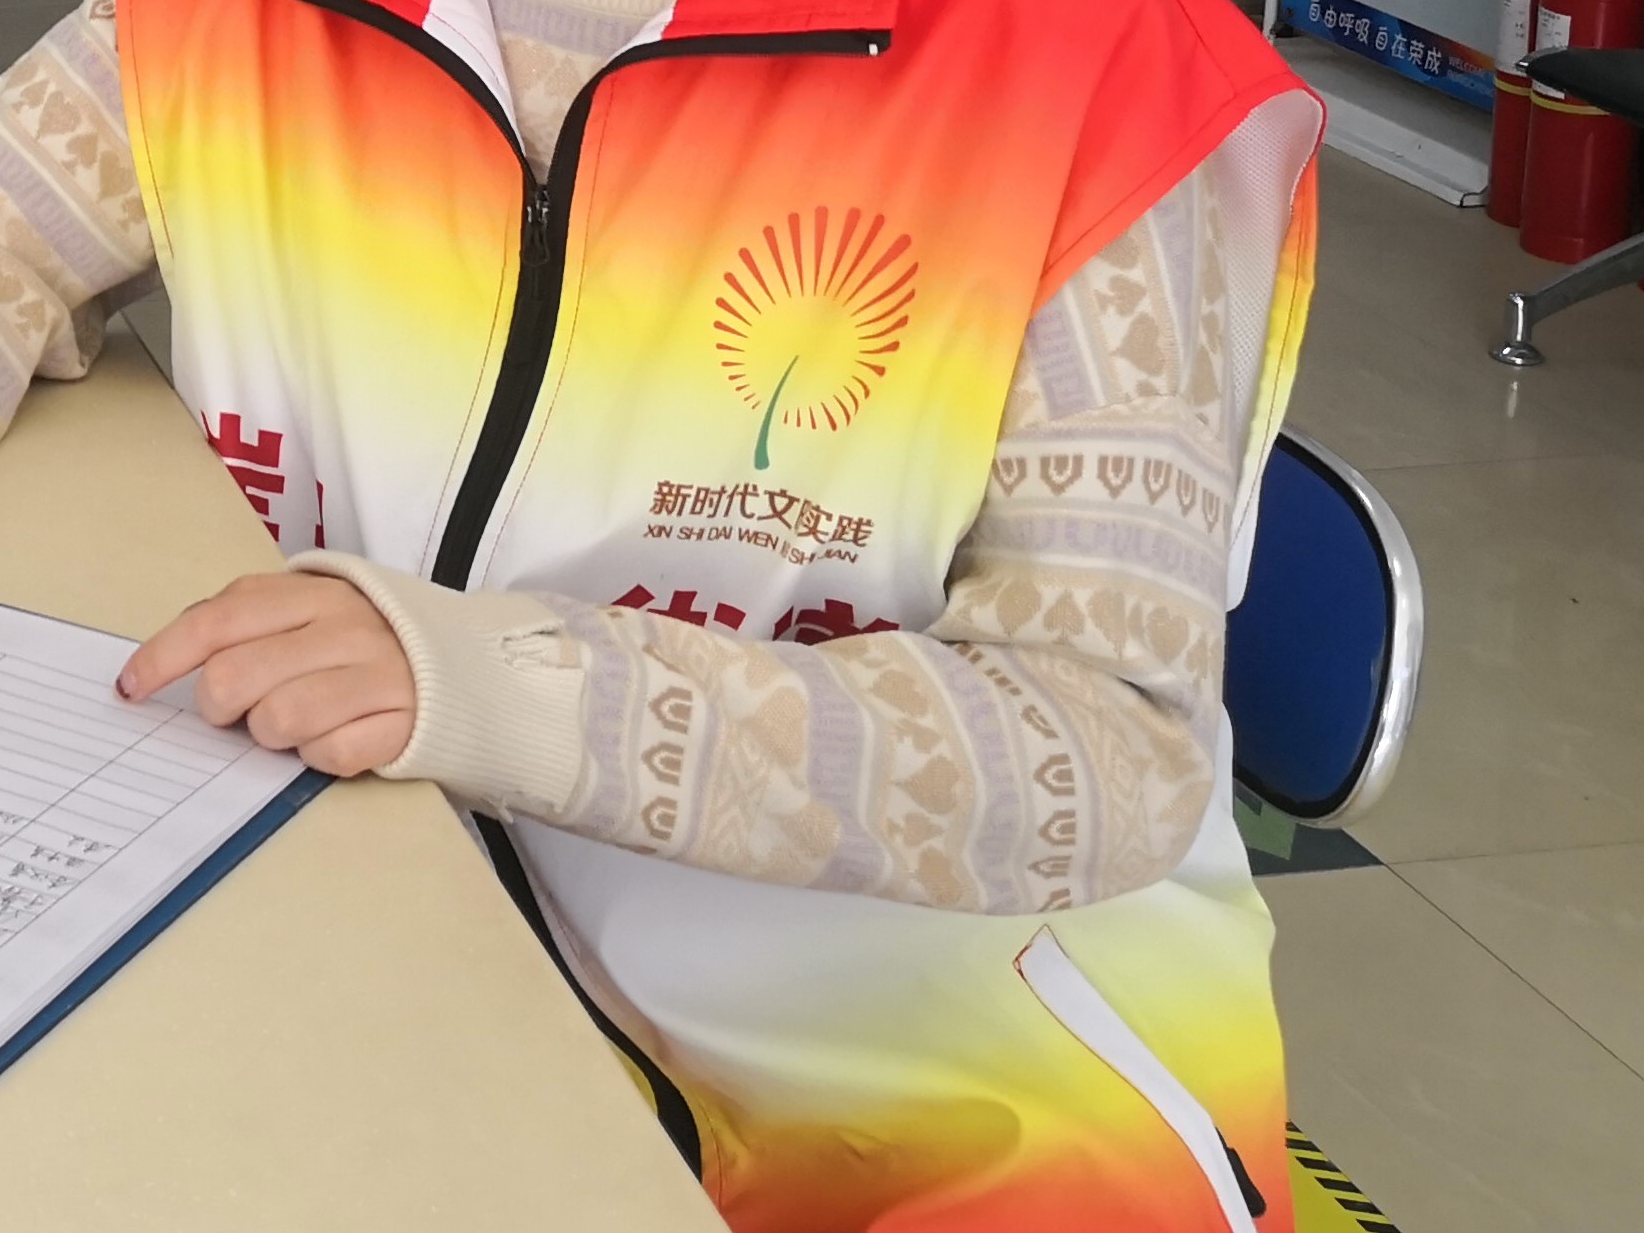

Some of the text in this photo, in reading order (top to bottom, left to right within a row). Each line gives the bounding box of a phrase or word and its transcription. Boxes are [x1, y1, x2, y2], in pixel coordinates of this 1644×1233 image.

[1375, 26, 1443, 75] 自在荣成
[649, 479, 875, 547] 新时代文实践
[643, 524, 673, 539] XIN
[676, 526, 705, 541] SHI
[707, 526, 733, 541] DAI
[737, 527, 779, 552] WEN
